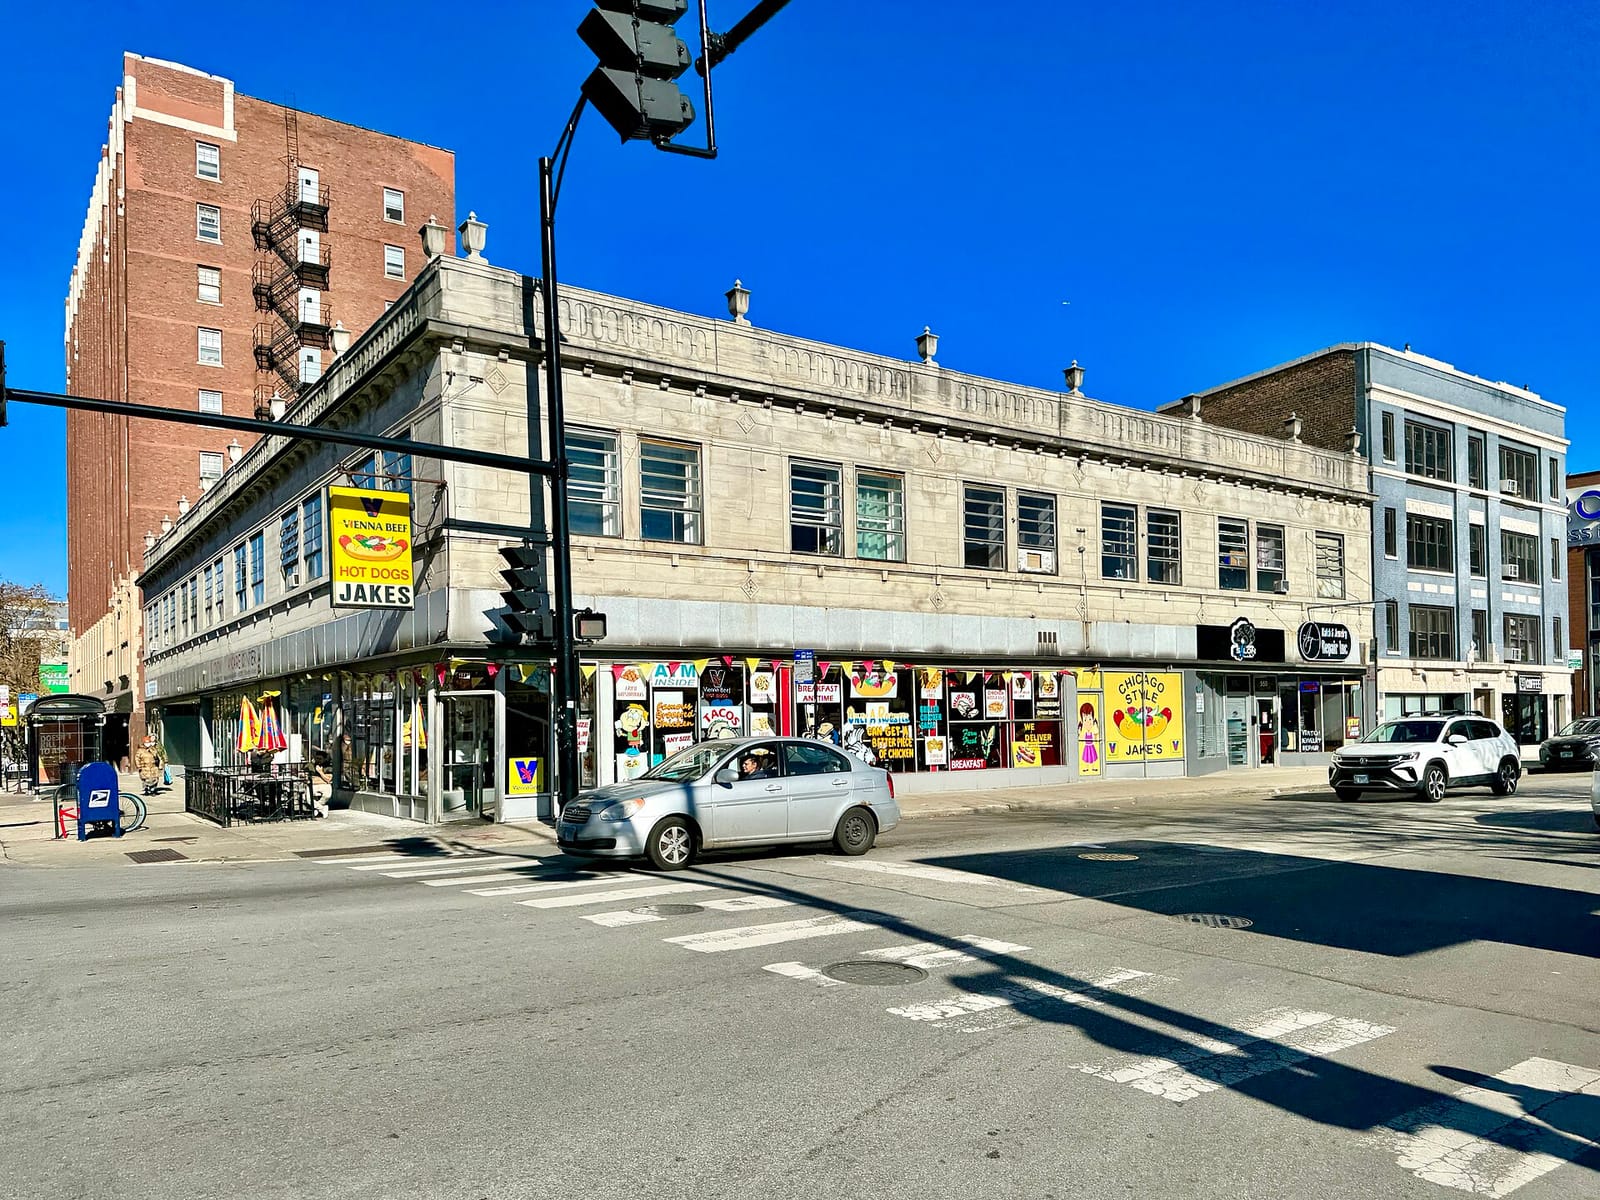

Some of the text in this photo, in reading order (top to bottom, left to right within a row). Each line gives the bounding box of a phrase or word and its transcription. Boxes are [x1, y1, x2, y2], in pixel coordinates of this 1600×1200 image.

[343, 519, 408, 533] VIENNA BEEF
[339, 565, 410, 580] HOT DOGS
[339, 583, 411, 605] JAKES
[654, 663, 696, 678] AM
[1118, 673, 1165, 695] CHICAGO
[802, 694, 834, 702] ANTIME
[1125, 689, 1159, 705] STYLE
[703, 708, 740, 726] TACOS
[866, 725, 883, 737] CAN
[1024, 723, 1035, 731] WE
[1024, 733, 1052, 742] DELIVER
[878, 748, 914, 759] OF CHICKEN
[1125, 743, 1163, 755] JAKE'S
[951, 758, 985, 769] BREAKFAST
